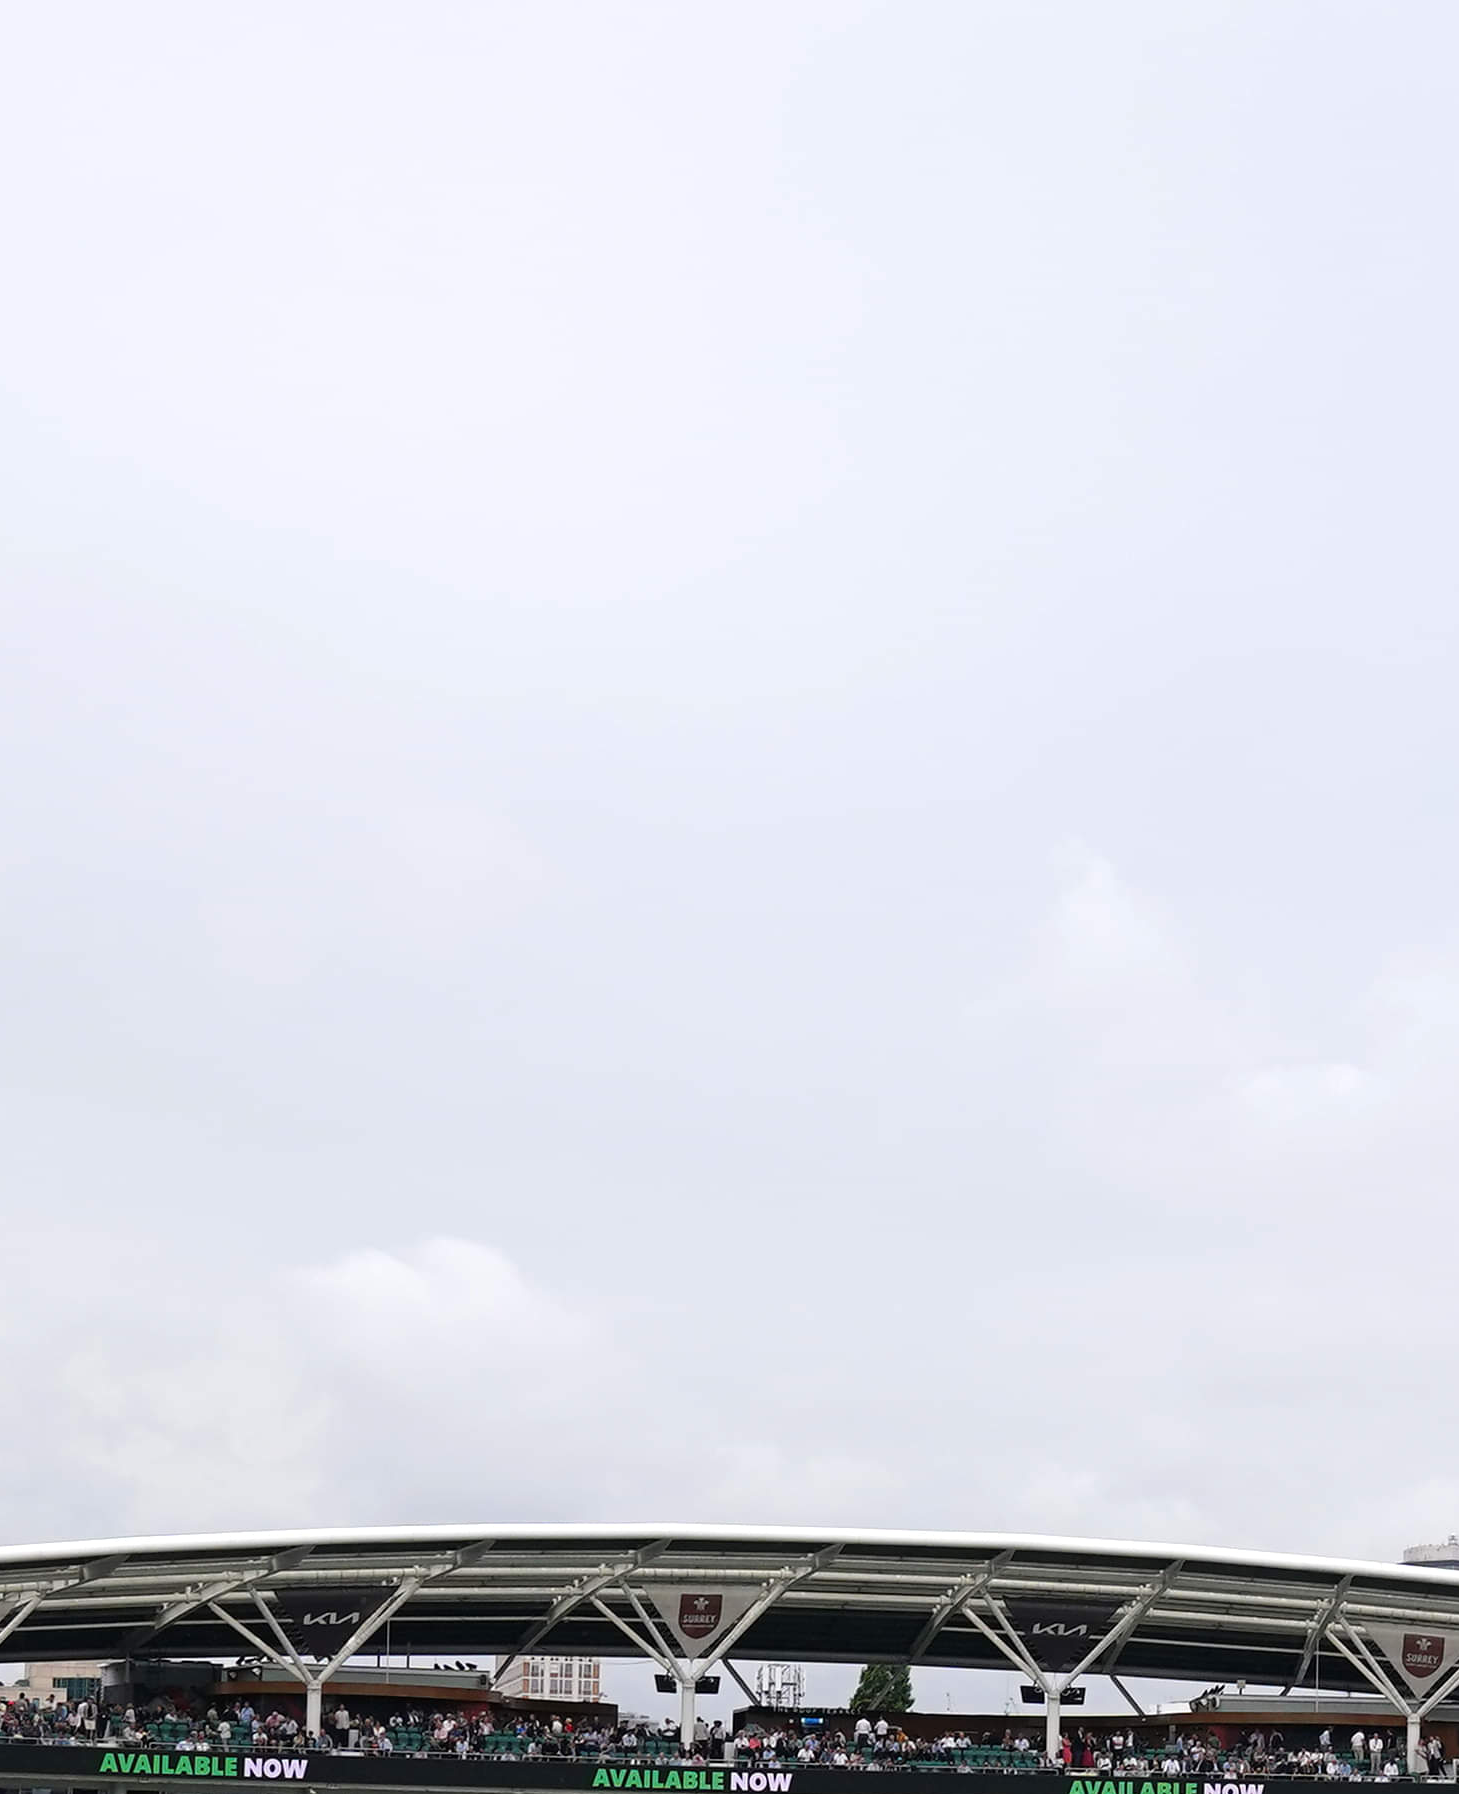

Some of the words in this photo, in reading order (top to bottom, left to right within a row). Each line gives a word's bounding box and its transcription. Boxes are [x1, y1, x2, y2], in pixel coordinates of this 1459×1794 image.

[682, 1614, 716, 1624] SURREY
[1406, 1653, 1439, 1664] SURREY
[100, 1753, 239, 1777] AVAILABLE
[243, 1758, 309, 1779] NOW
[592, 1768, 724, 1790] AVAILABLE
[730, 1773, 793, 1793] NOW
